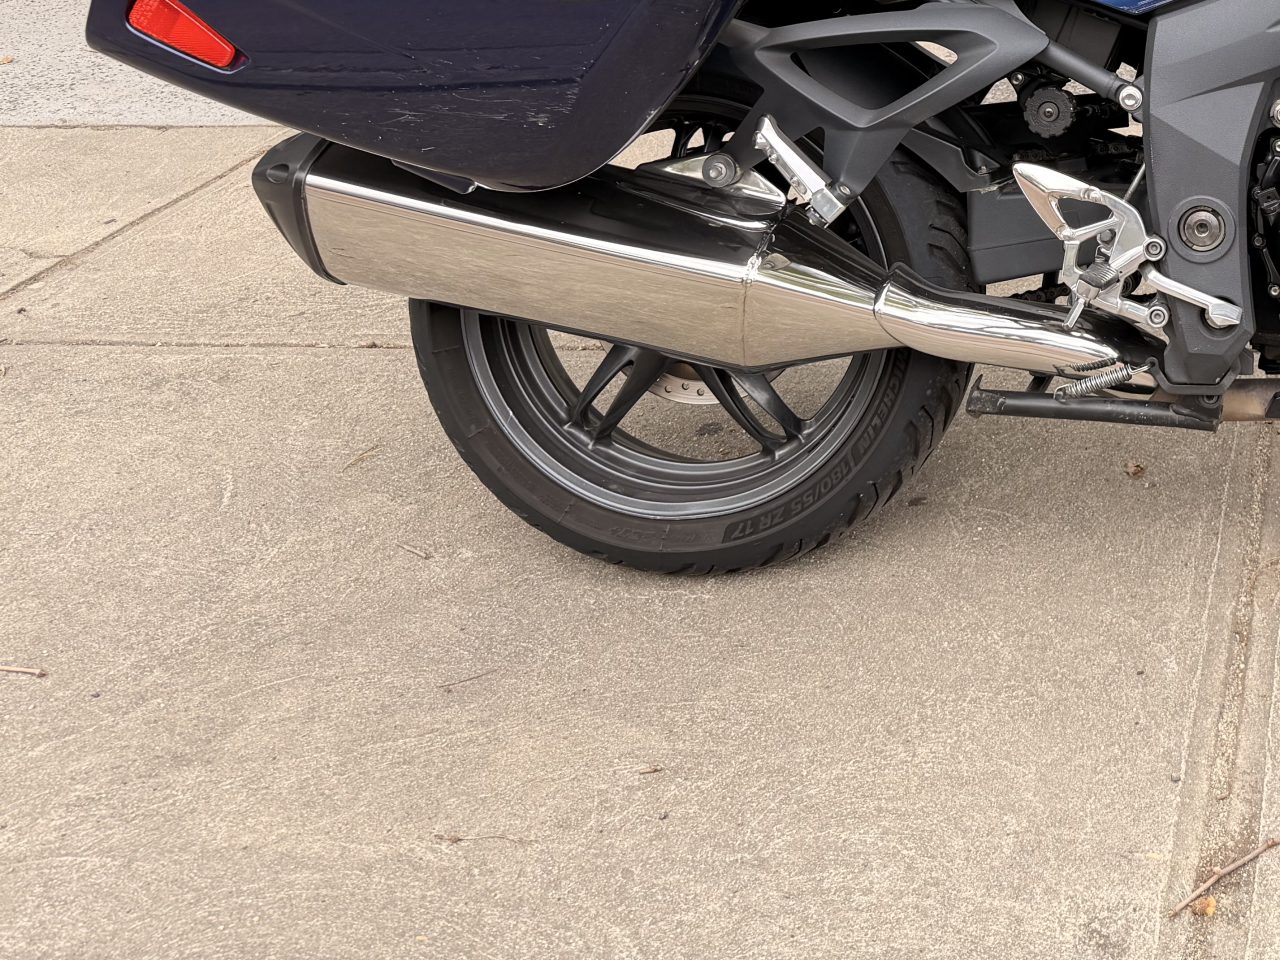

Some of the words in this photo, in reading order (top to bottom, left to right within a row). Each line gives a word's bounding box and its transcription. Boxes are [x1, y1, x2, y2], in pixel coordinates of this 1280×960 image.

[859, 349, 909, 455] MICHELIN
[790, 464, 849, 515] 180/55
[731, 520, 754, 539] 17
[760, 507, 785, 529] ZR
